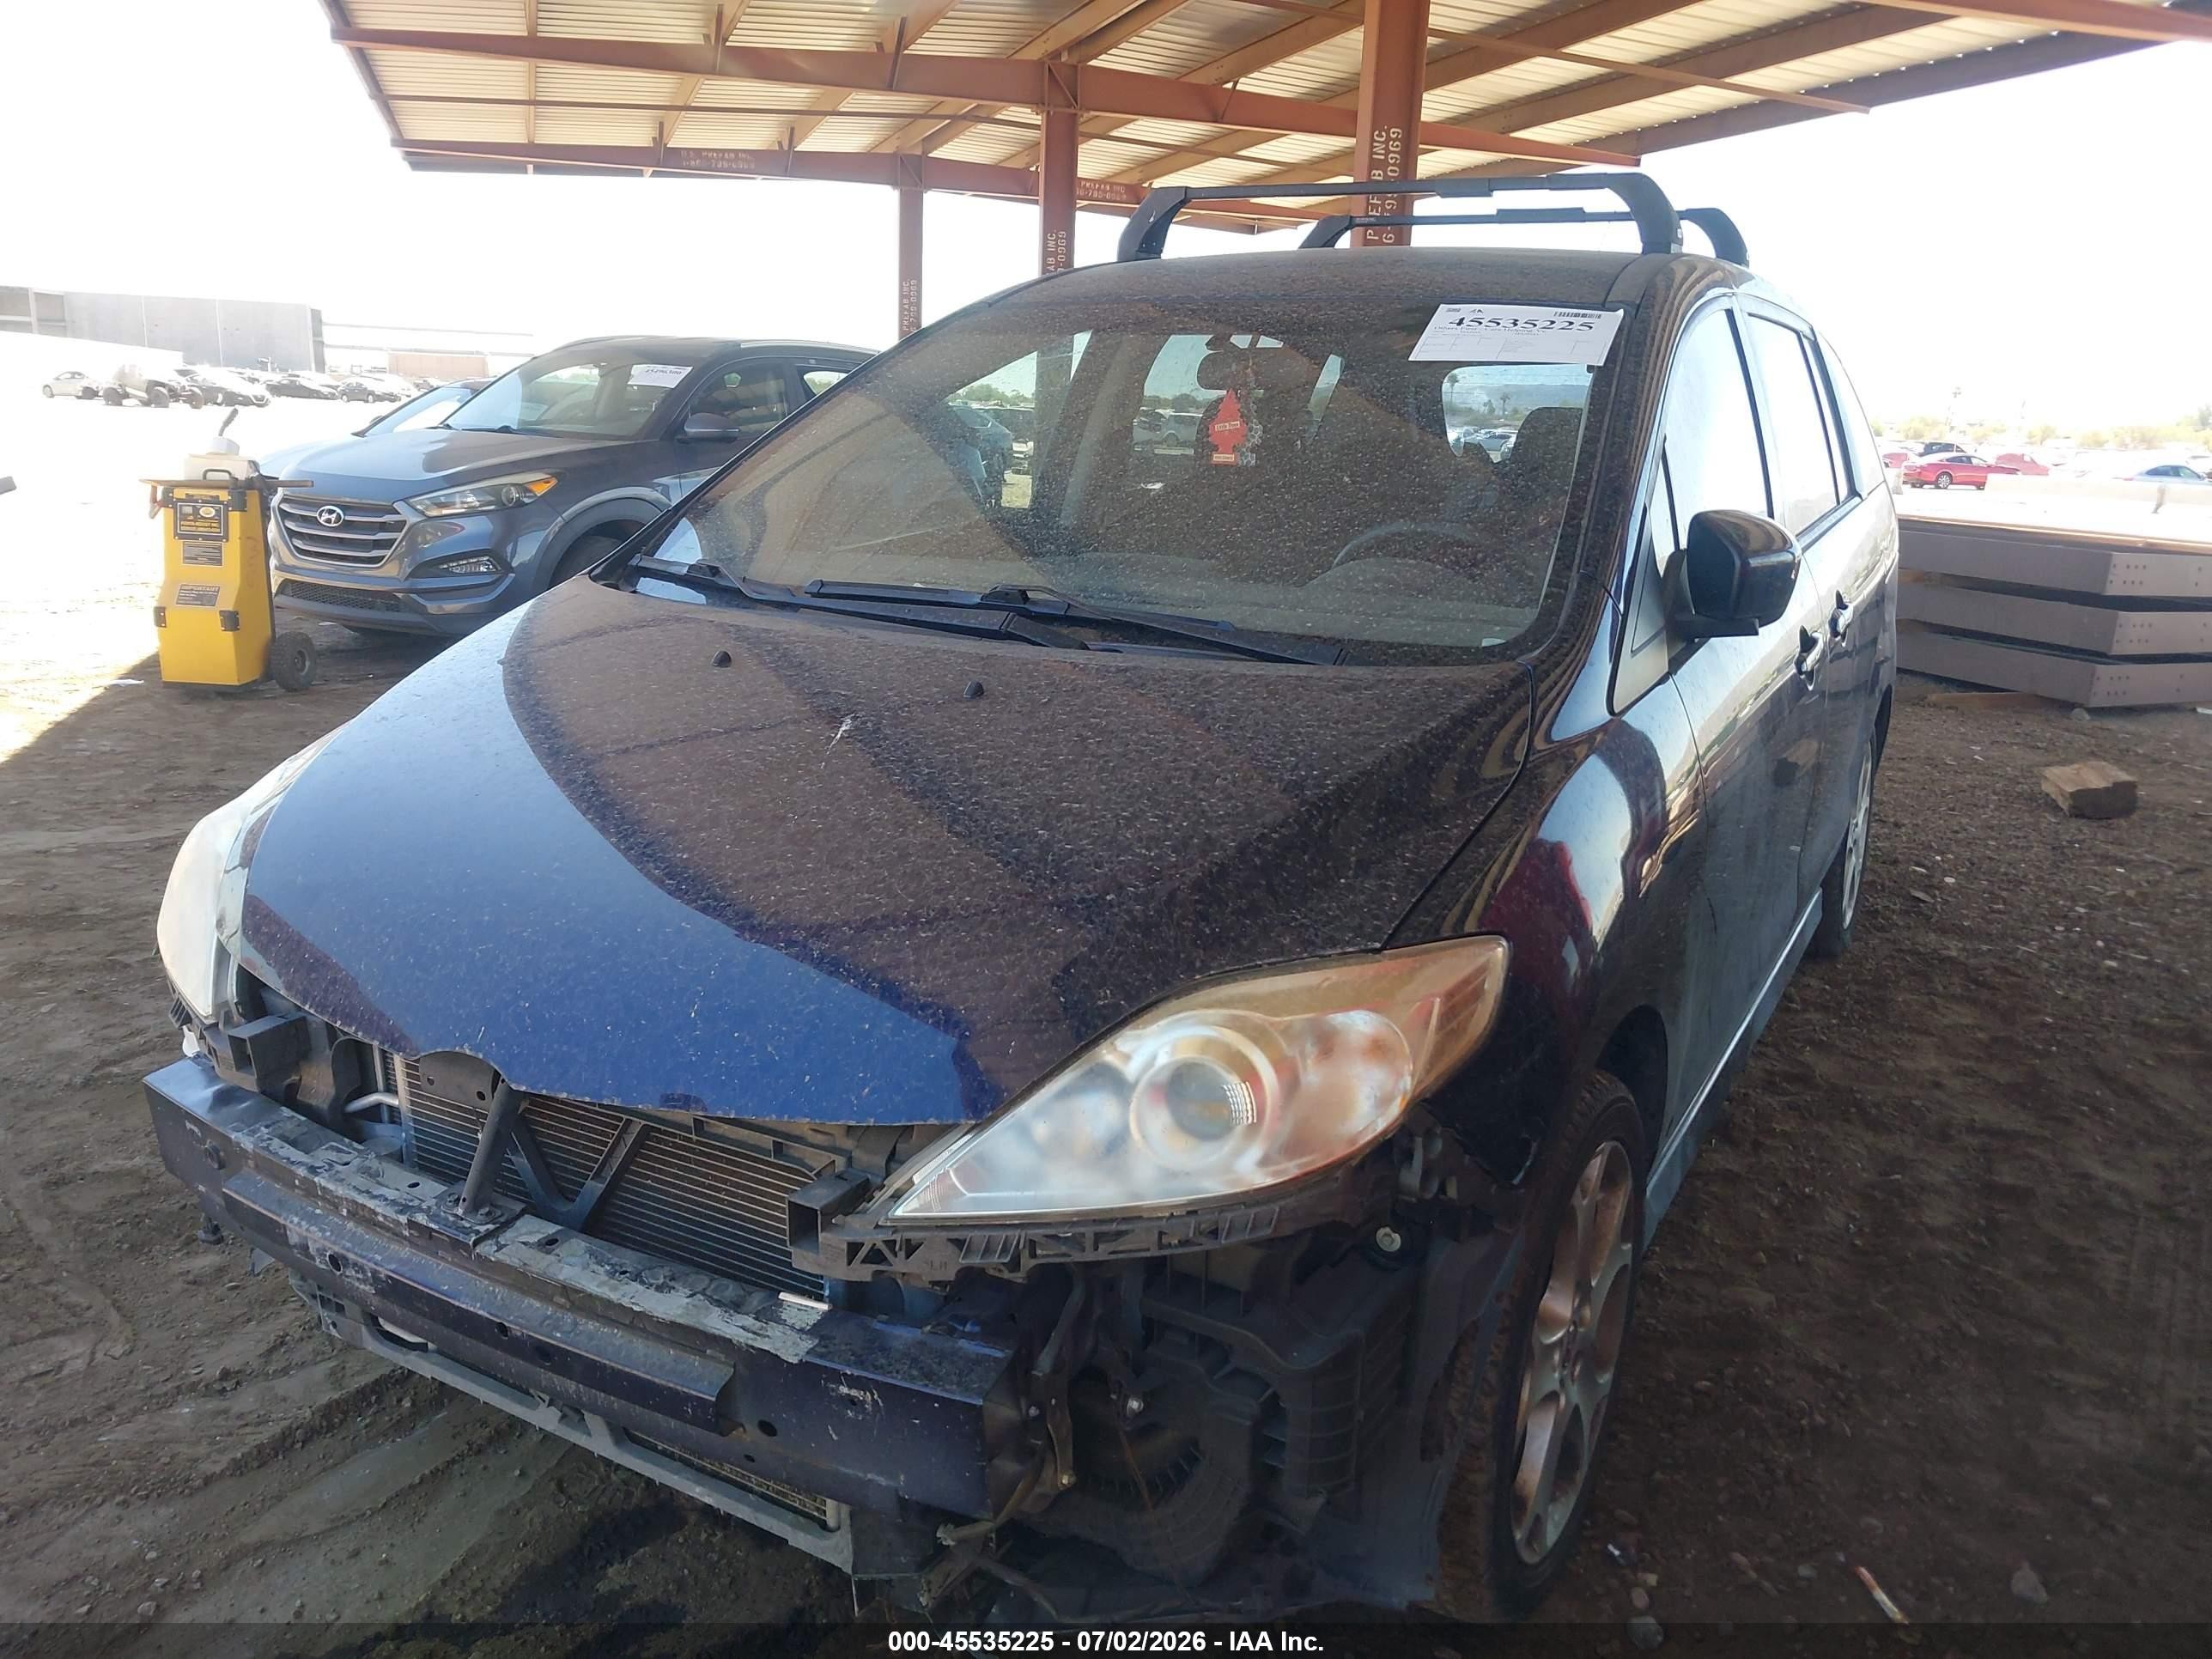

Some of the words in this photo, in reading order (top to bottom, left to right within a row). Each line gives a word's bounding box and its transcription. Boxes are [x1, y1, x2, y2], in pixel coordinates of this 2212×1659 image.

[1371, 125, 1389, 160] INC.
[1366, 169, 1384, 240] PEFB
[1047, 229, 1057, 252] INC.
[1448, 316, 1595, 331] 45535225
